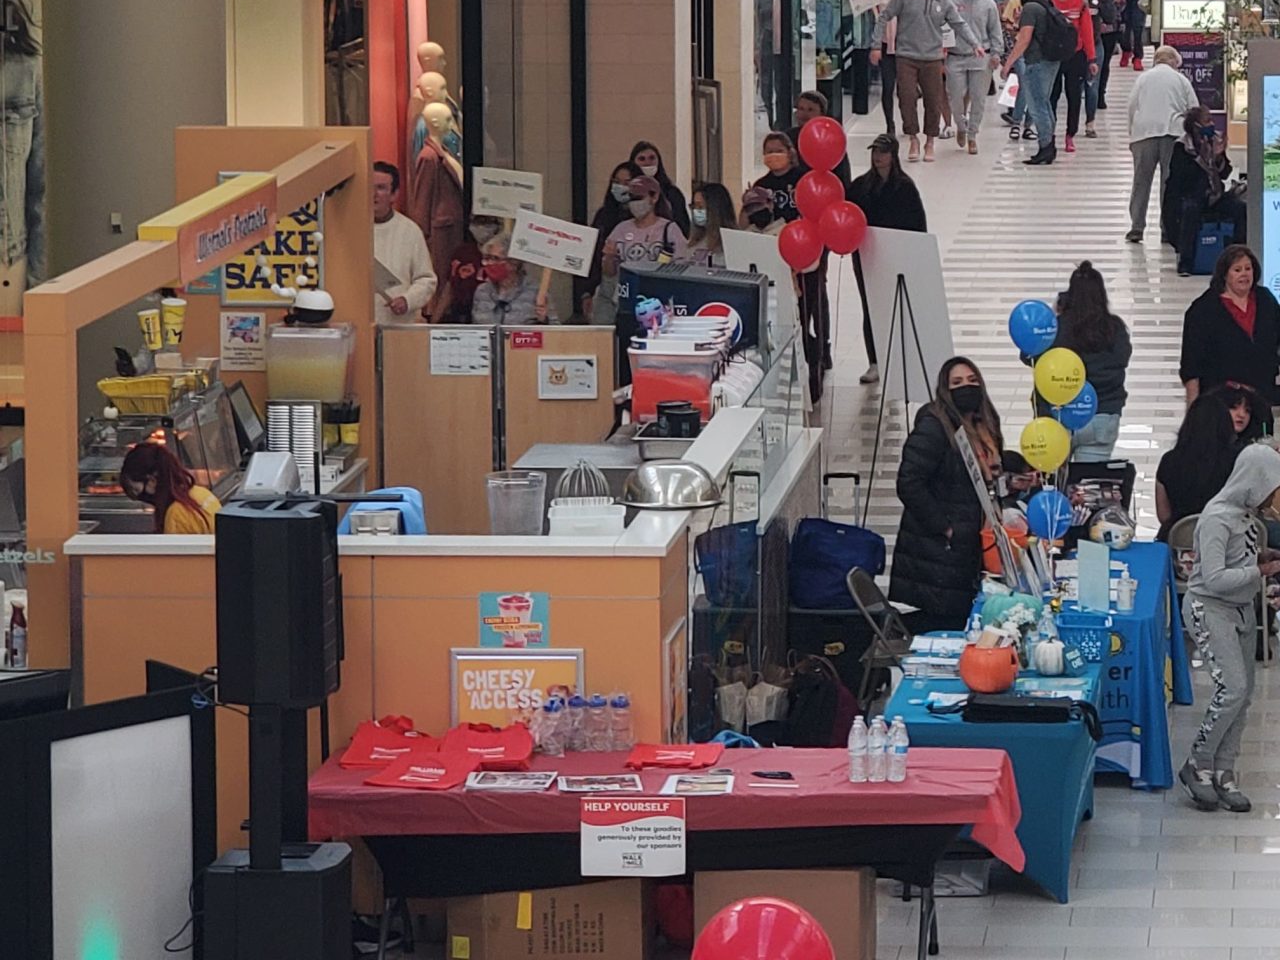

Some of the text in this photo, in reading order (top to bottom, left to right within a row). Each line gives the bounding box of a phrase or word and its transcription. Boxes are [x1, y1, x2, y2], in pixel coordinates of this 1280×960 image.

[1195, 69, 1214, 81] OFF
[225, 263, 319, 290] SAFE
[462, 668, 536, 691] CHEESY
[469, 689, 543, 710] ACCESS
[584, 802, 670, 812] HELP YOURSELF
[597, 833, 682, 842] generously provided by
